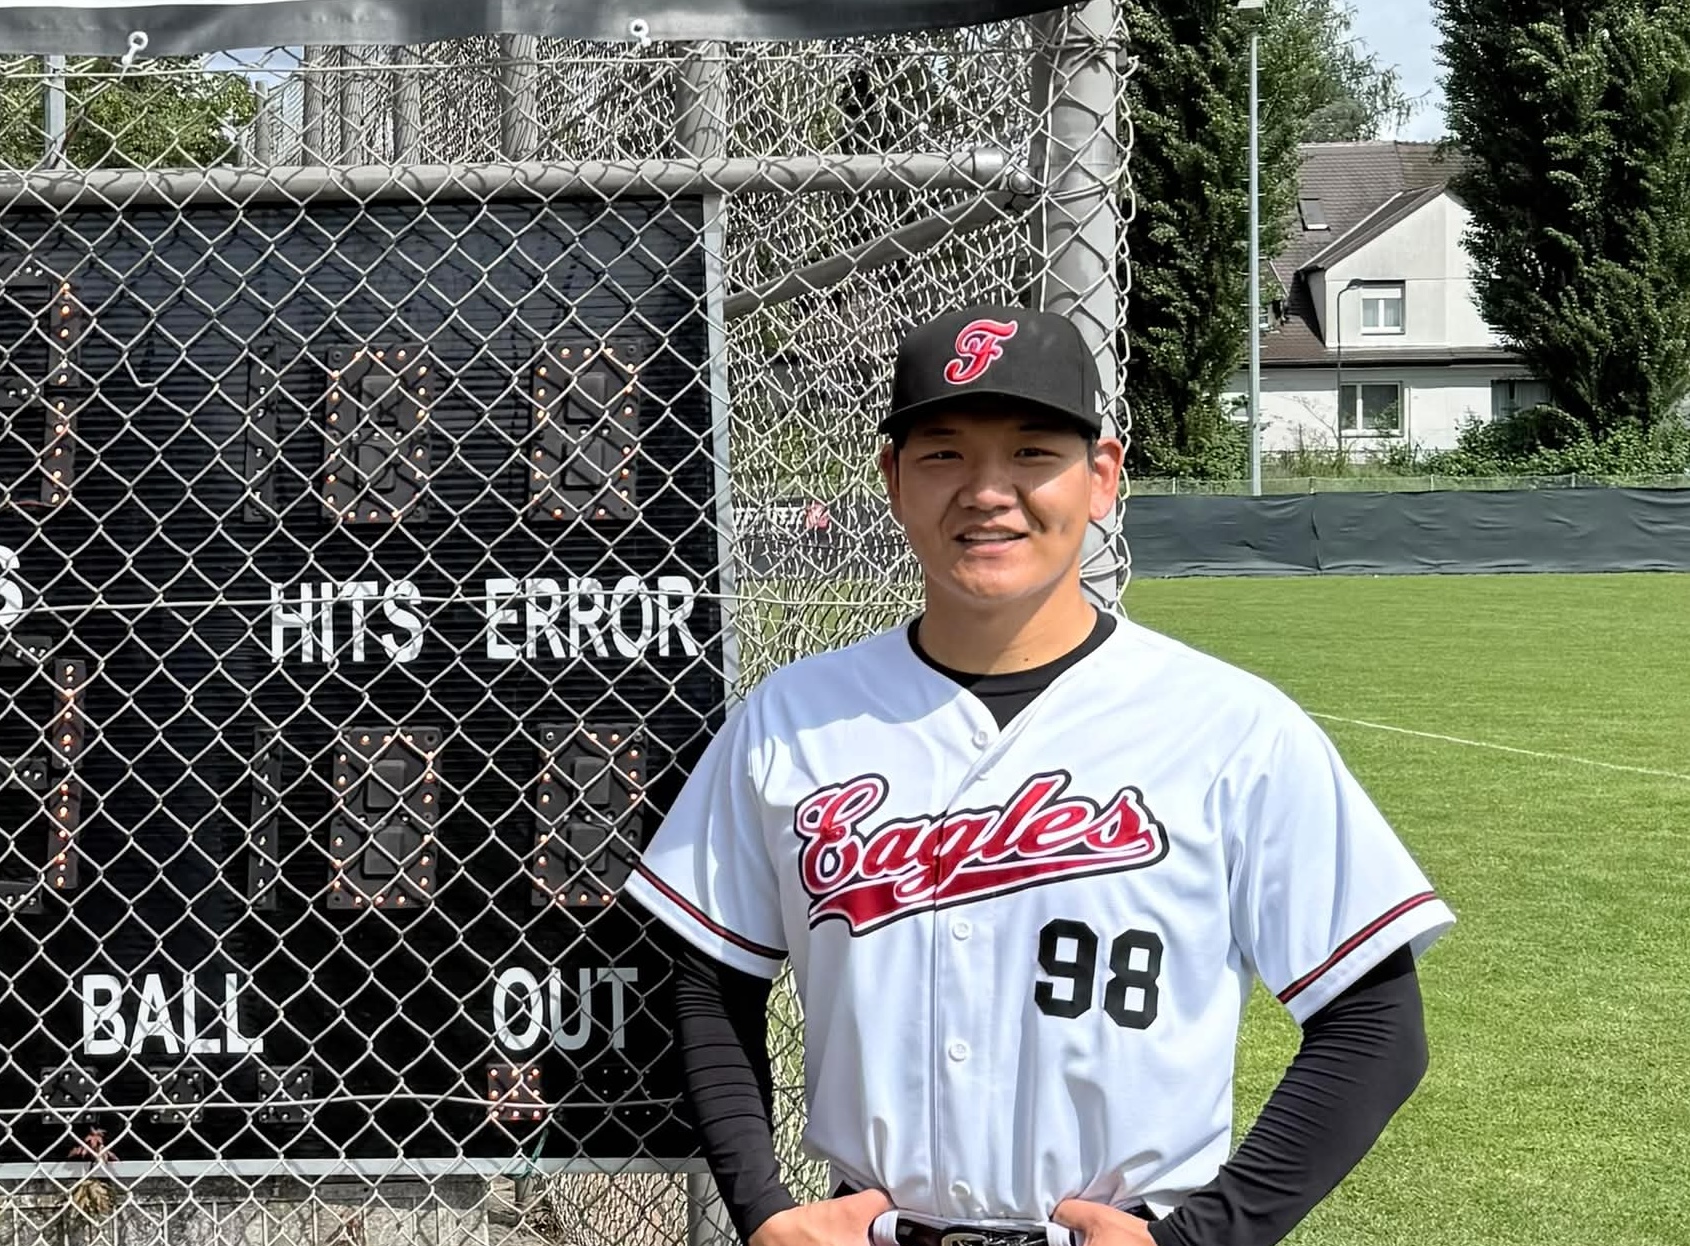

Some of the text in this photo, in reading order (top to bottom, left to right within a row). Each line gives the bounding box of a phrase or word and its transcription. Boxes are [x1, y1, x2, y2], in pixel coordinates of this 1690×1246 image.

[943, 319, 1018, 385] F
[271, 580, 424, 663] HITS
[485, 575, 700, 660] ERROR
[794, 769, 1170, 912] Eagles
[82, 973, 264, 1056] BALL
[492, 967, 638, 1050] OUT
[1034, 918, 1164, 1030] 98
